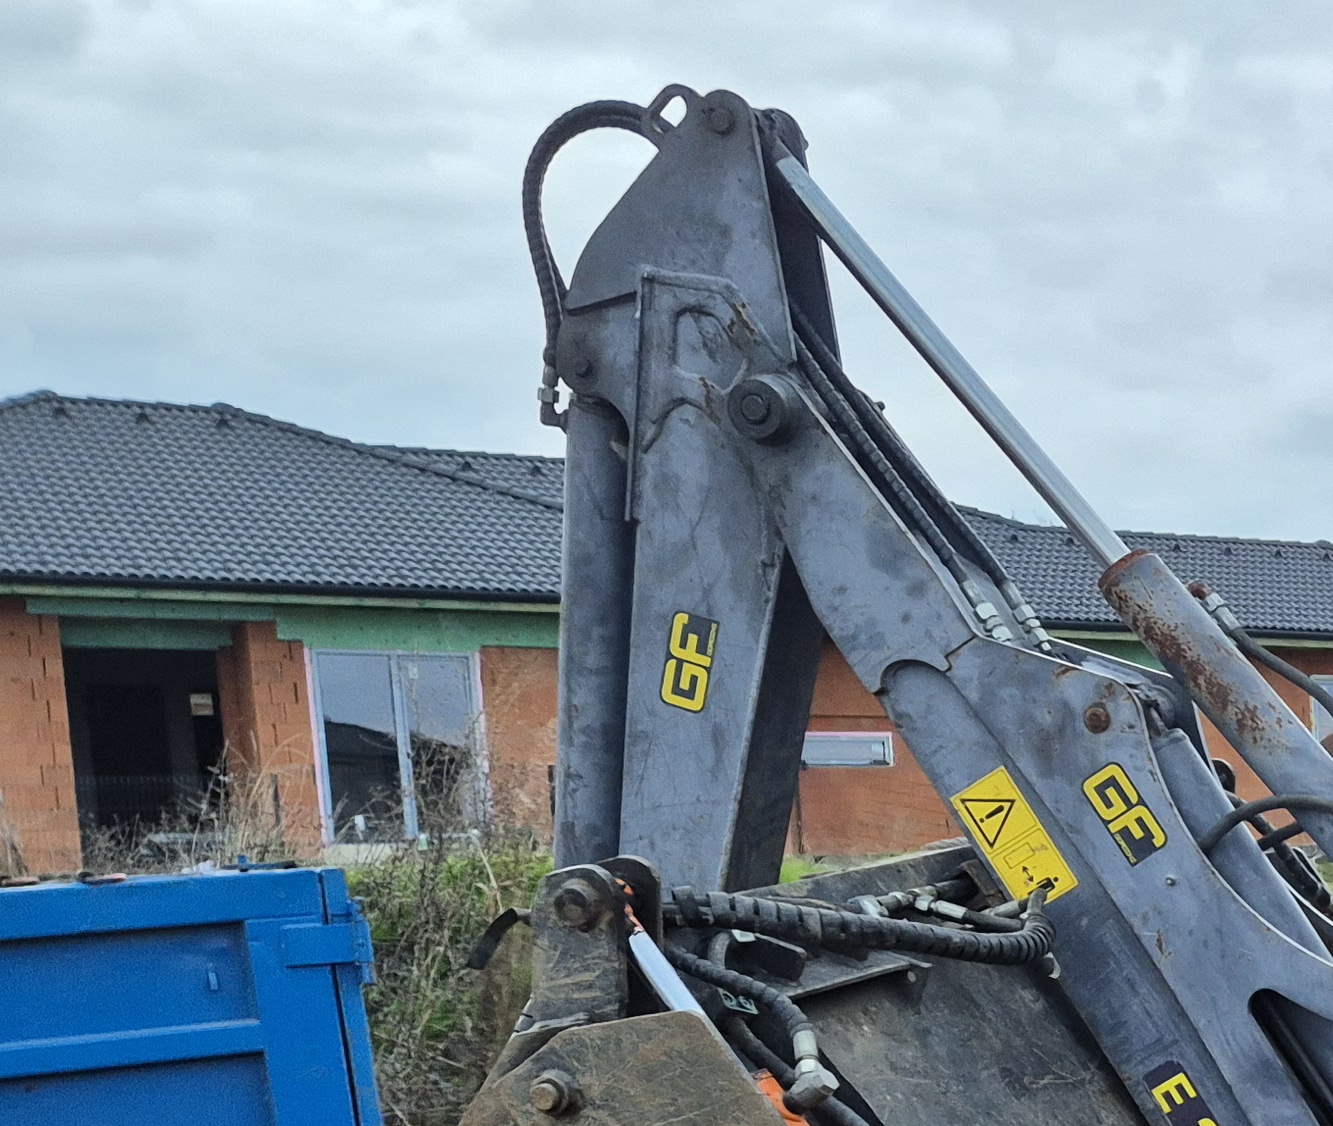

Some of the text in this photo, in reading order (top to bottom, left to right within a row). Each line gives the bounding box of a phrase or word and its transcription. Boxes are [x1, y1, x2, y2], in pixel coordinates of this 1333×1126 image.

[661, 612, 712, 711] GF
[1083, 764, 1166, 848] GF
[1151, 1072, 1197, 1114] E
